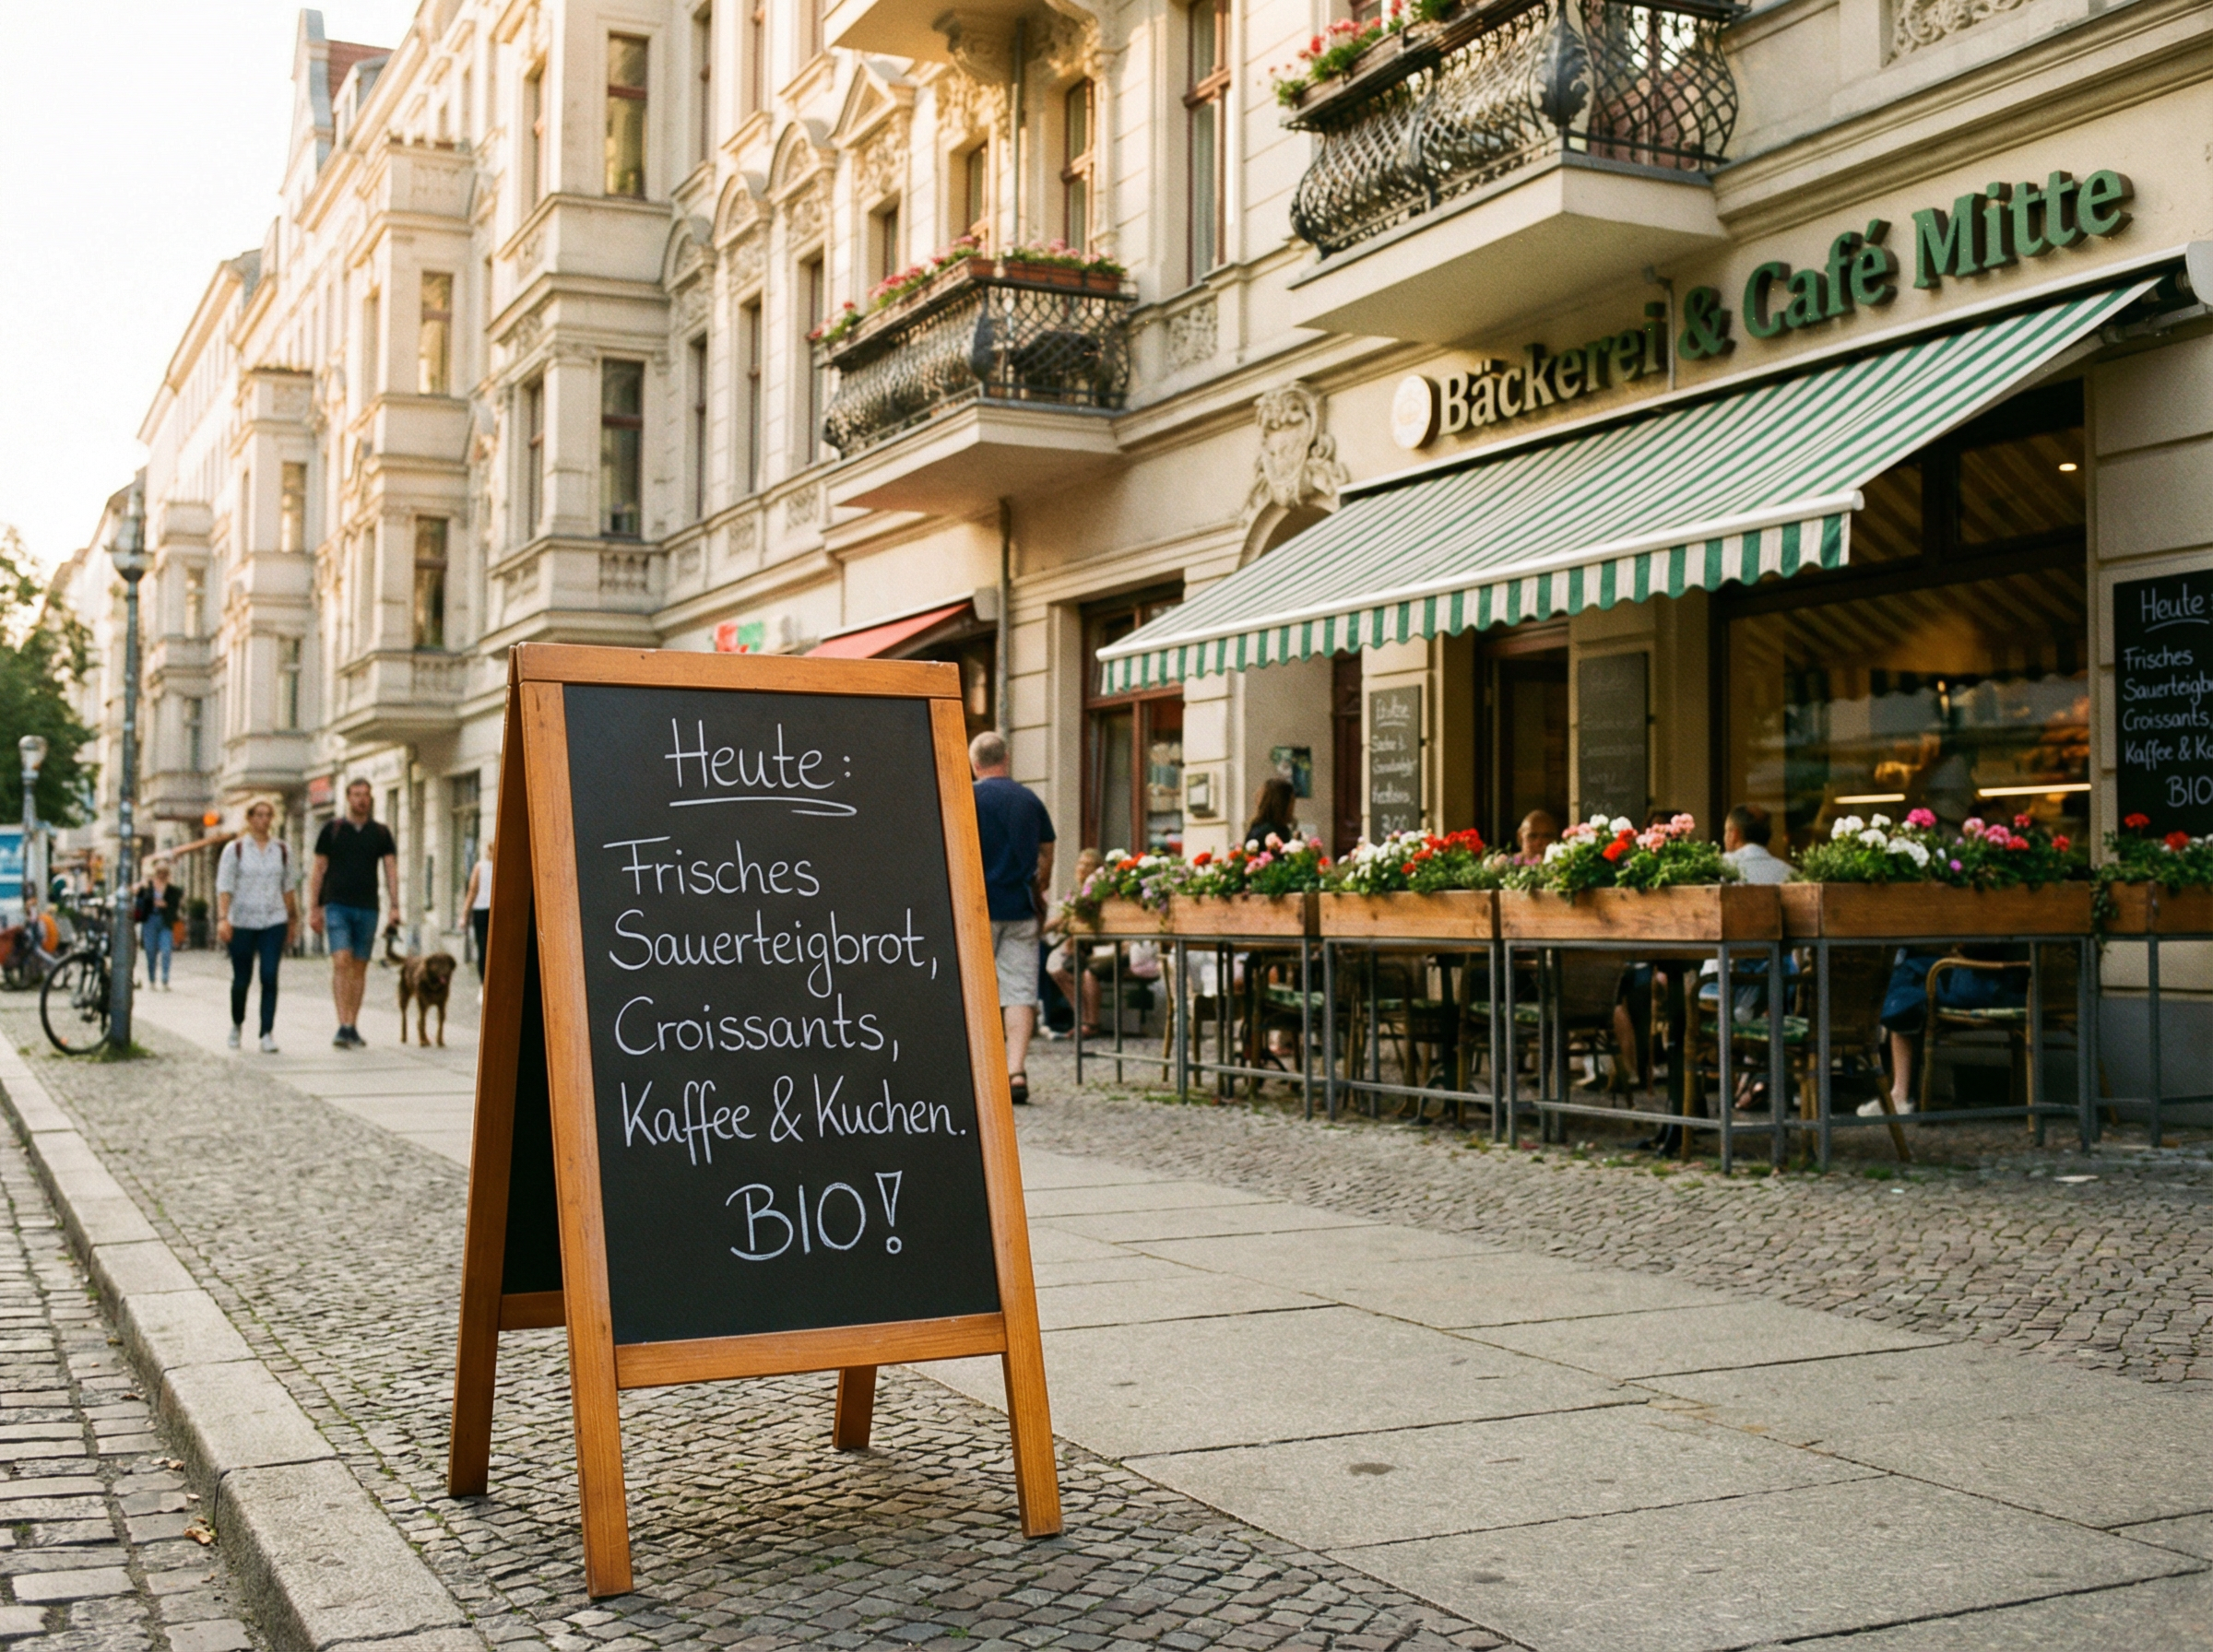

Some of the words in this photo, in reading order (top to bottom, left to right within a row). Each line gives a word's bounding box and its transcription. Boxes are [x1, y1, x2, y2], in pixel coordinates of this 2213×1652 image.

[1439, 301, 1667, 435] Bäckerei
[1678, 285, 1735, 360] &
[1742, 218, 1899, 338] Café
[1911, 170, 2134, 289] Mitte
[2123, 670, 2213, 706] Sauerteigb
[2124, 644, 2194, 671] Frisches
[664, 717, 851, 790] Heute:
[2124, 738, 2173, 772] Kaffee
[2178, 735, 2192, 761] &
[2165, 775, 2213, 808] BIO
[602, 835, 820, 897] Frisches
[609, 907, 938, 997] Sauerteigbrot,
[615, 994, 899, 1062] Croissants,
[621, 1080, 757, 1165] Kaffee
[770, 1075, 804, 1143] &
[813, 1073, 966, 1138] Kuchen.
[725, 1170, 903, 1262] BIO!
